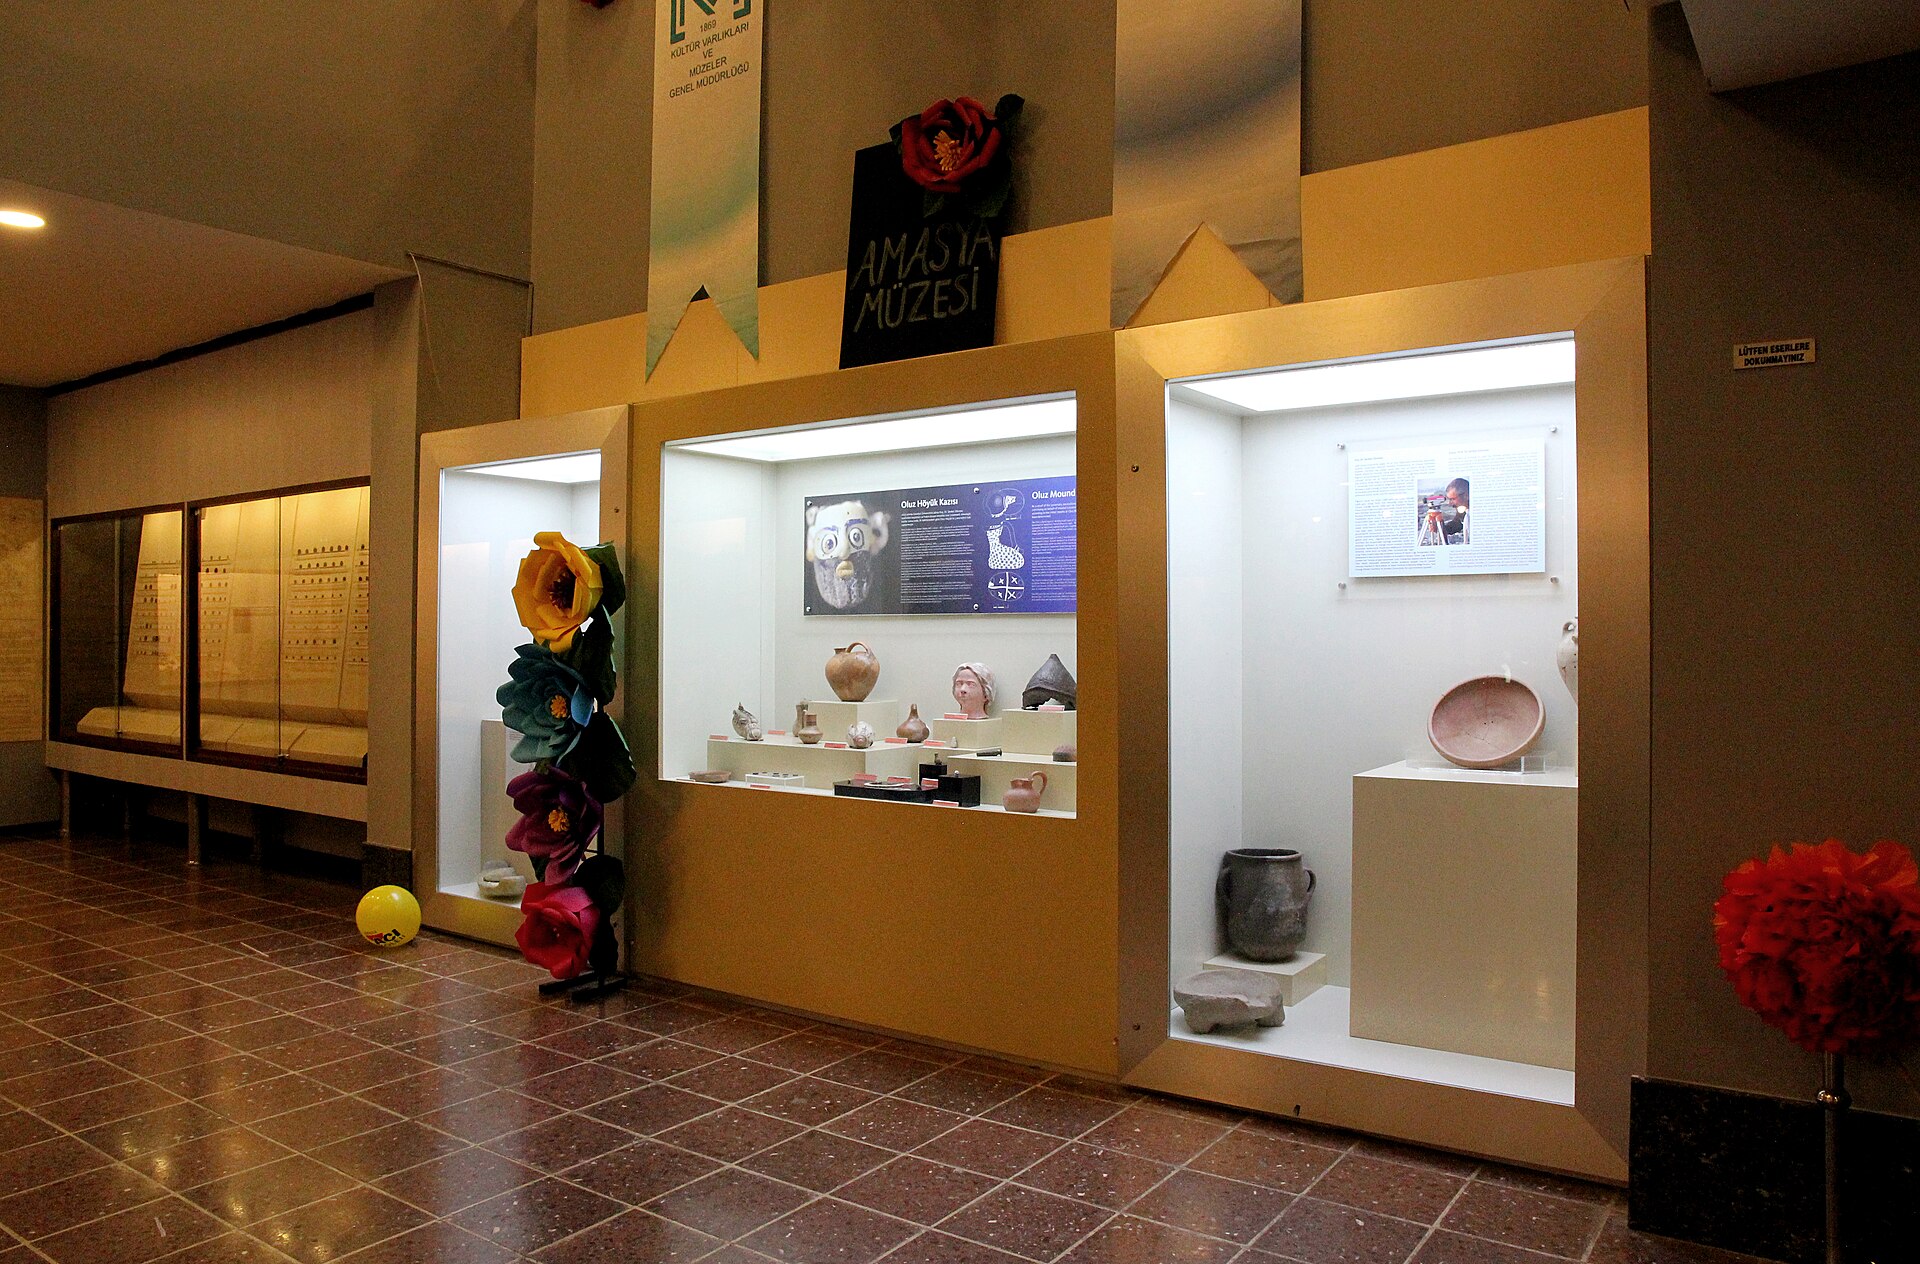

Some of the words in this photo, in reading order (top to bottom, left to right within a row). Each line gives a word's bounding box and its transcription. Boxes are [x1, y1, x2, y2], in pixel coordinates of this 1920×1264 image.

[699, 20, 717, 33] 1869
[670, 40, 701, 59] KÜLTÜR
[702, 21, 749, 47] VARLIKLARI
[703, 48, 714, 59] VE
[689, 56, 727, 78] MÜZELER
[669, 83, 695, 98] GENEL
[696, 61, 750, 89] MÜDÜRLÜĞÜ
[850, 219, 996, 290] AMASYA
[852, 266, 979, 333] MÜZESİ
[1738, 345, 1769, 357] LÜTFEN
[1770, 341, 1810, 353] ESERLERE
[1743, 353, 1805, 367] DOKUNMAYINIZ
[1031, 490, 1049, 500] Oluz
[1050, 488, 1076, 499] Mound
[901, 501, 917, 509] Oluz
[917, 499, 938, 509] Höyük
